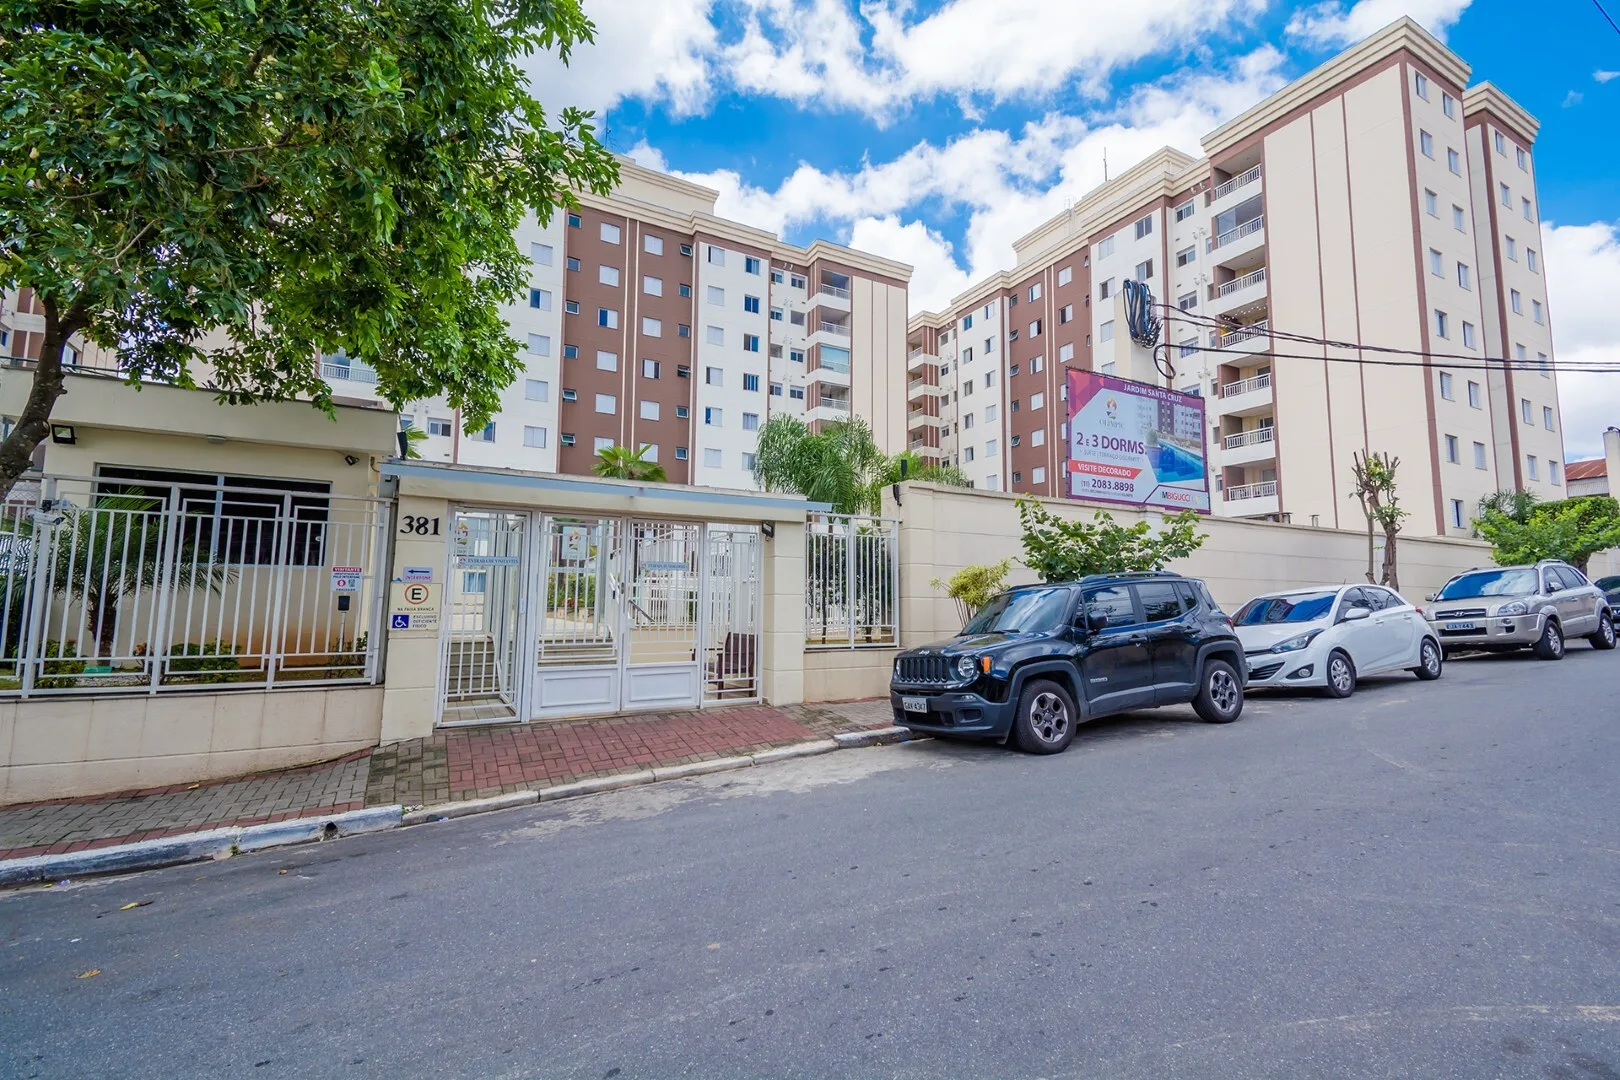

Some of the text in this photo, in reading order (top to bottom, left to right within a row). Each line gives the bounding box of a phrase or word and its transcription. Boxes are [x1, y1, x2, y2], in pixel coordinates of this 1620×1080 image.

[1123, 384, 1183, 403] JARDIM SANTA CRUZ
[1076, 432, 1148, 455] 2 E 3 DORMS.
[1077, 463, 1132, 477] VISITE DECORADO
[1091, 478, 1135, 493] 2083.8898
[1161, 491, 1191, 503] MBIGUCCI
[399, 515, 441, 536] 381
[411, 587, 423, 600] E
